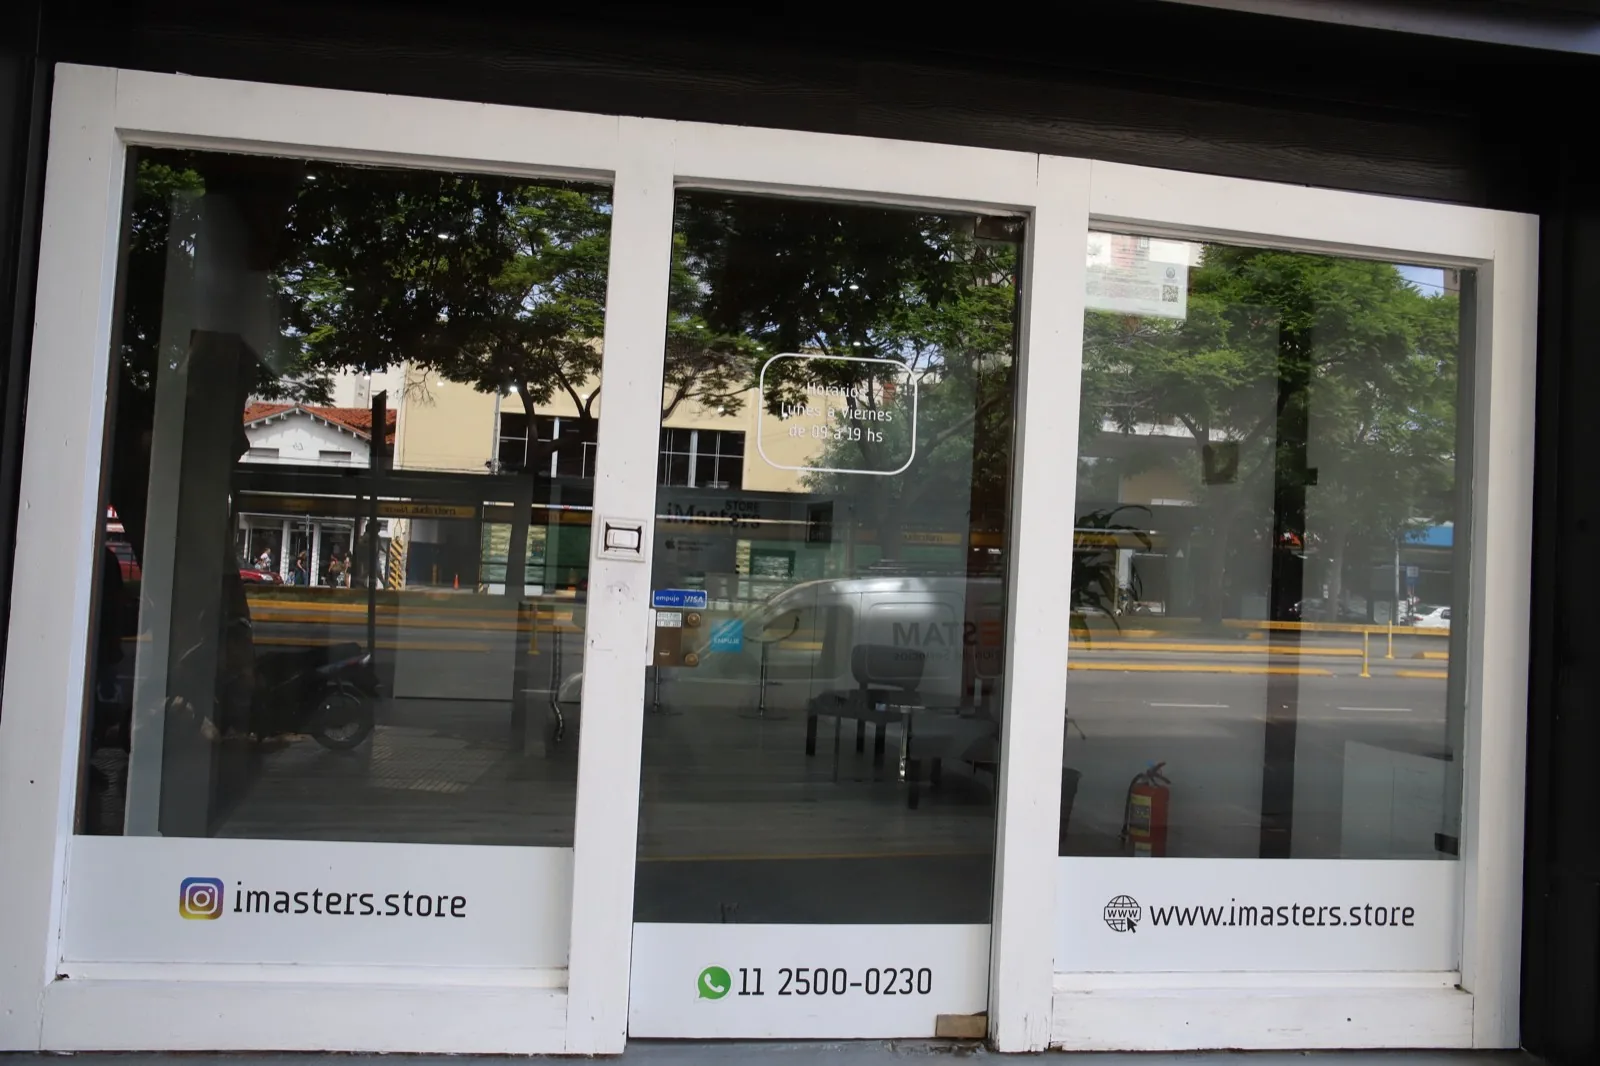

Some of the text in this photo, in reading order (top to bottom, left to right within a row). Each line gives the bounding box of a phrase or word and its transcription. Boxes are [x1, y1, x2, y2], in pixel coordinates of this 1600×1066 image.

[781, 402, 821, 417] Lunes
[827, 407, 836, 418] a
[789, 424, 883, 442] de 09 a 19 hs
[725, 500, 760, 512] STORE
[665, 502, 761, 529] iMasters
[655, 595, 704, 604] empuje VISA
[713, 636, 740, 646] EMPUJE
[233, 881, 468, 918] imasters.store
[1149, 898, 1416, 928] www.imasters.store
[738, 967, 932, 996] 11 2500-0230
